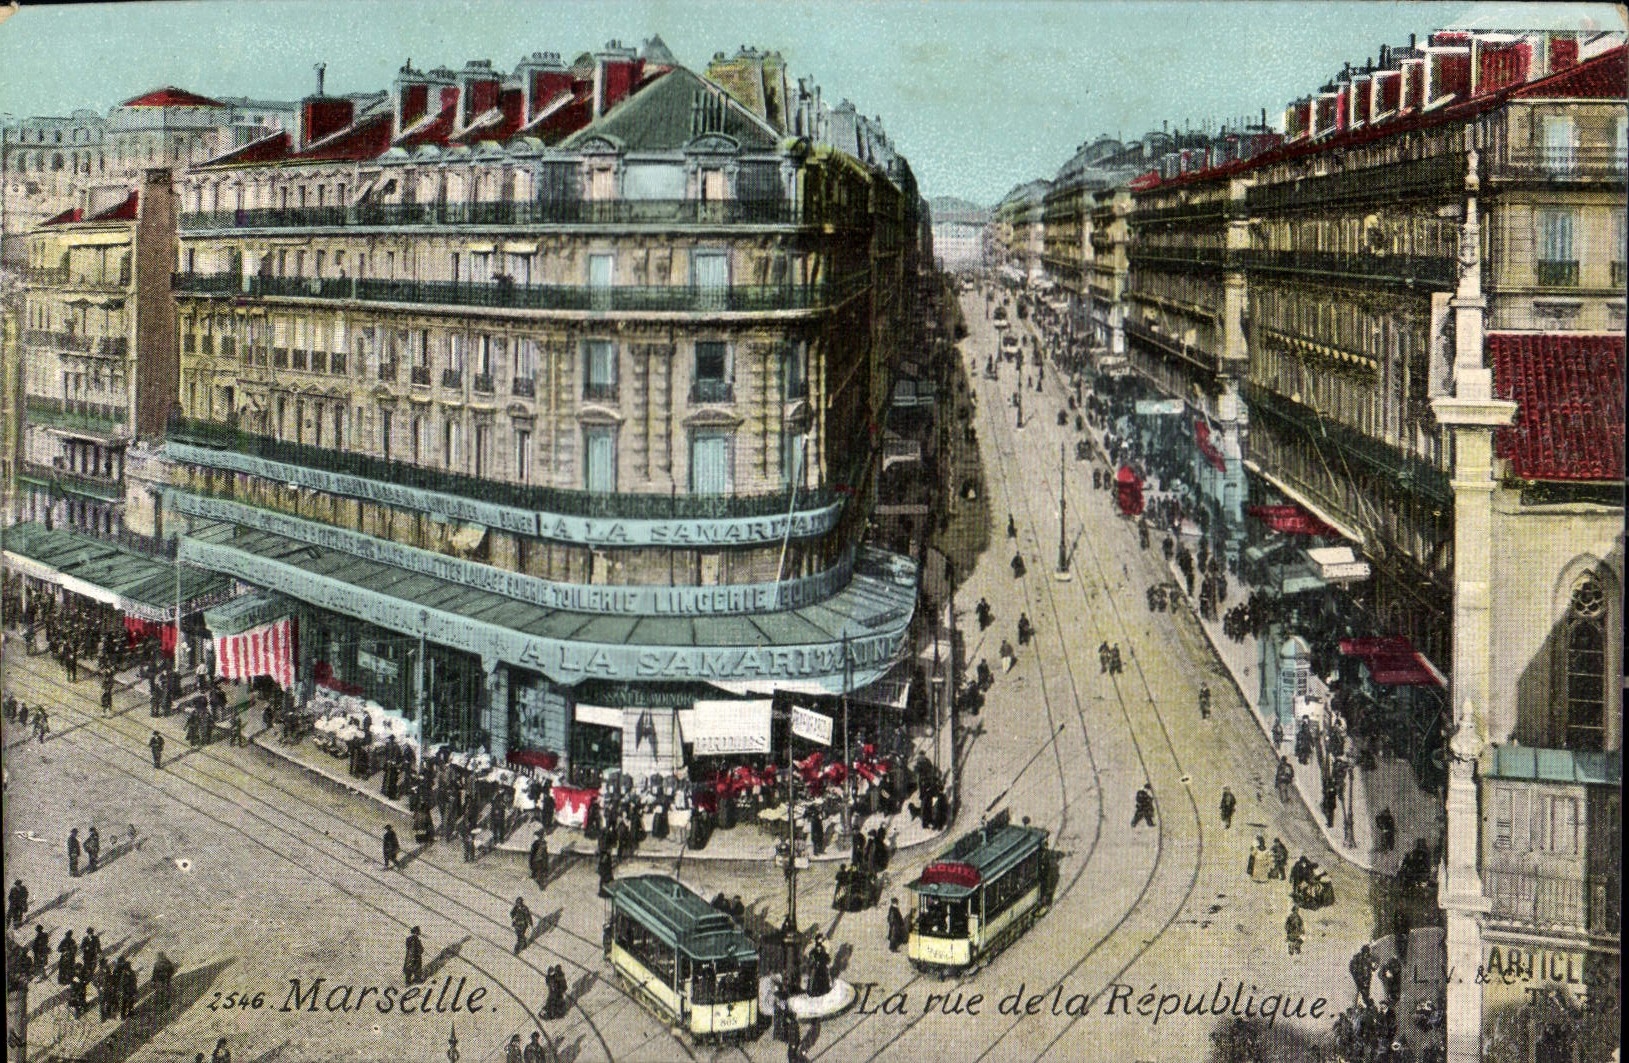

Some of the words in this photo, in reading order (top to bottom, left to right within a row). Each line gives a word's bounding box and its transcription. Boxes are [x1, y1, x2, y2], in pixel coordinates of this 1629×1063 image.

[552, 518, 572, 540] A
[584, 520, 635, 543] LA
[653, 588, 769, 614] LINGERIE
[519, 638, 546, 669] A
[558, 645, 618, 675] LA
